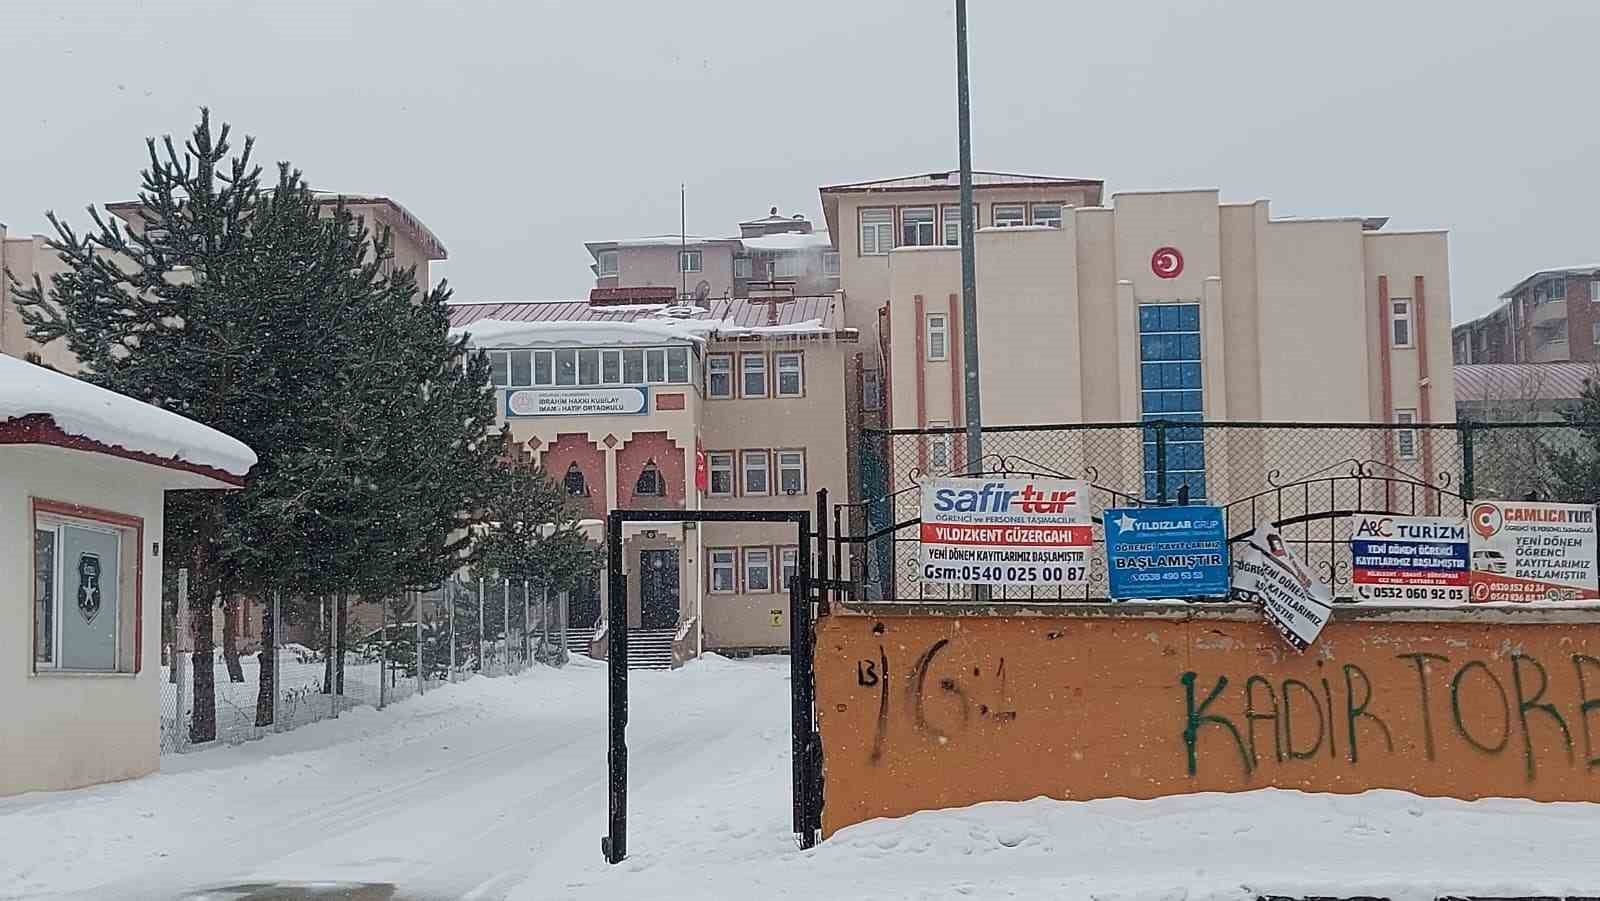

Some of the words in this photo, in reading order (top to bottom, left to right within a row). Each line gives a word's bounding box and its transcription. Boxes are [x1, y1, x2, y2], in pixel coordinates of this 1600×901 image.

[985, 515, 1025, 524] PERSONEL
[1135, 520, 1192, 531] YILDIZLAR
[1193, 520, 1219, 529] GRUP
[935, 526, 1003, 541] YILDIZKENT
[1005, 526, 1072, 543] GÜZERGAHI
[1357, 518, 1393, 537] A&C
[1397, 522, 1465, 540] TURİZM
[1515, 534, 1542, 546] YENİ
[1543, 536, 1583, 547] DÖNEM
[929, 547, 948, 561] YENİ
[949, 547, 976, 562] DÖNEM
[976, 551, 1031, 562] KAYITLARIMIZ
[1033, 551, 1084, 565] BAŞLAMIŞTIR
[1515, 545, 1566, 558] ÖĞRENCİ
[1115, 553, 1222, 571] BAŞLAMIŞTIR
[1515, 559, 1591, 569] KAYITLARIMIZ
[1007, 567, 1037, 582] 025
[1042, 567, 1063, 582] 00
[1515, 569, 1587, 580] BAŞLAMIŞTIR
[1374, 587, 1403, 598] 0532
[1406, 588, 1428, 599] 060
[1431, 588, 1446, 600] 92
[1449, 589, 1464, 600] 03
[1180, 659, 1395, 776] KADİR
